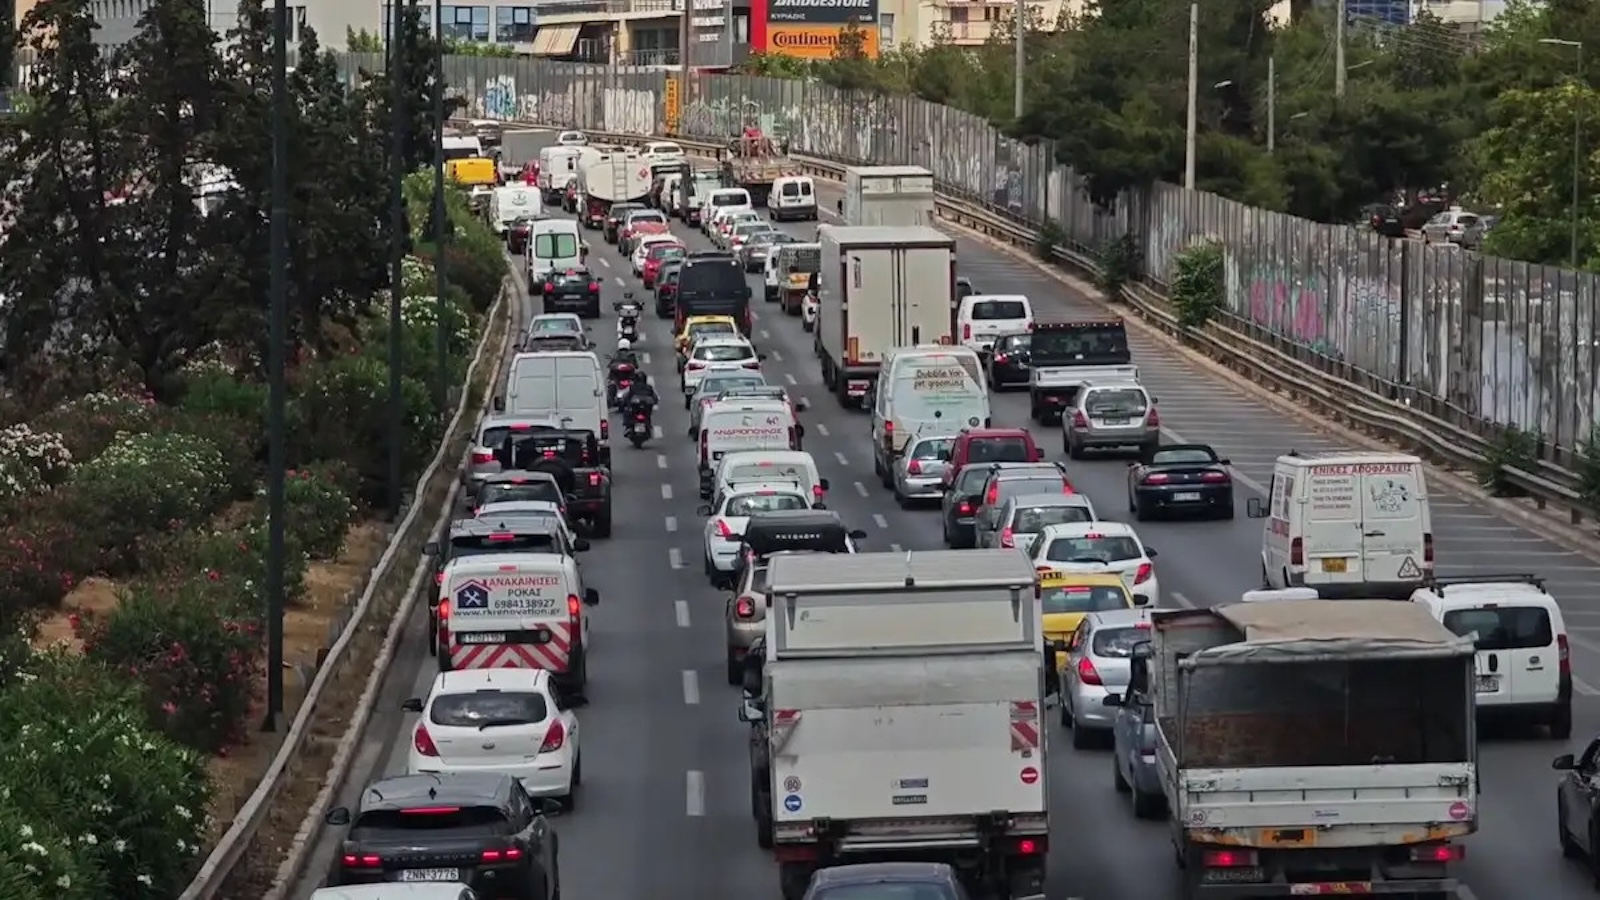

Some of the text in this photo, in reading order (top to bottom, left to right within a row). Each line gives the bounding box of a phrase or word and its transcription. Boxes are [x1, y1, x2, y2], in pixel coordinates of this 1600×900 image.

[507, 588, 542, 597] ΡΟΚΑΣ
[494, 600, 555, 608] 6984138927
[453, 607, 560, 616] www.rkrenovation.gr
